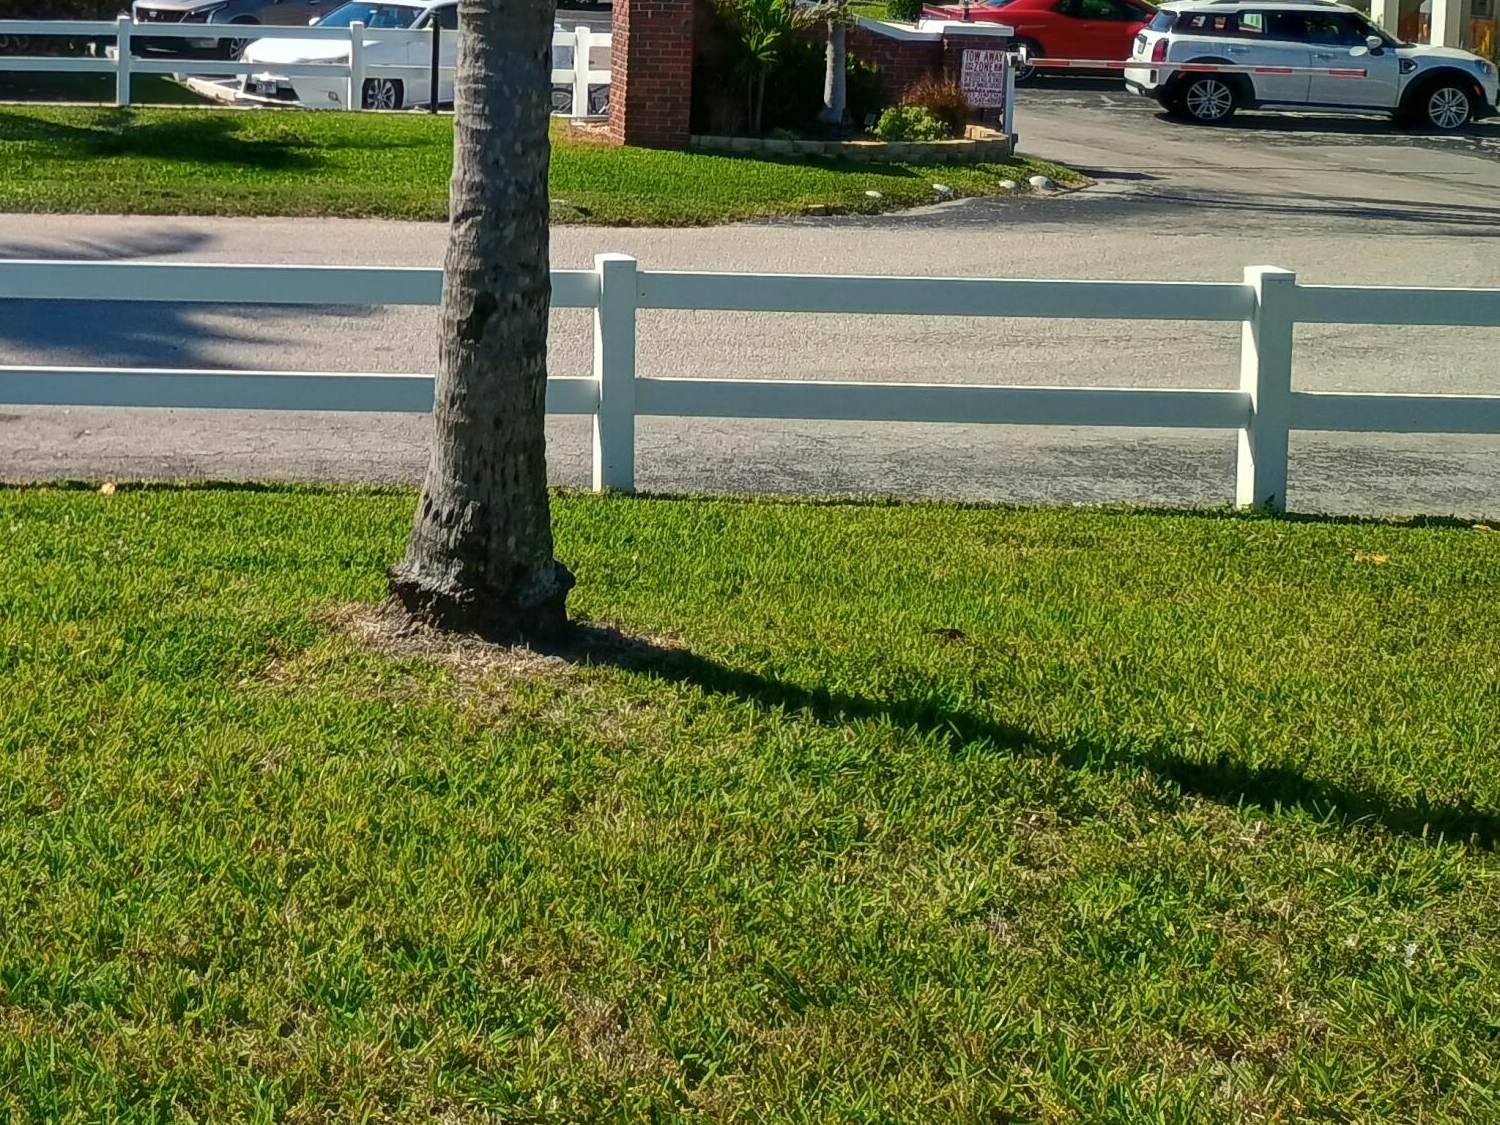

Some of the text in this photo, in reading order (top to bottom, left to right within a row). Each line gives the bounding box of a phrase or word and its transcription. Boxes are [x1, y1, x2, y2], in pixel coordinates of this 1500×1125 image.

[965, 50, 1004, 63] TOW AWAY
[973, 61, 993, 73] ZONE
